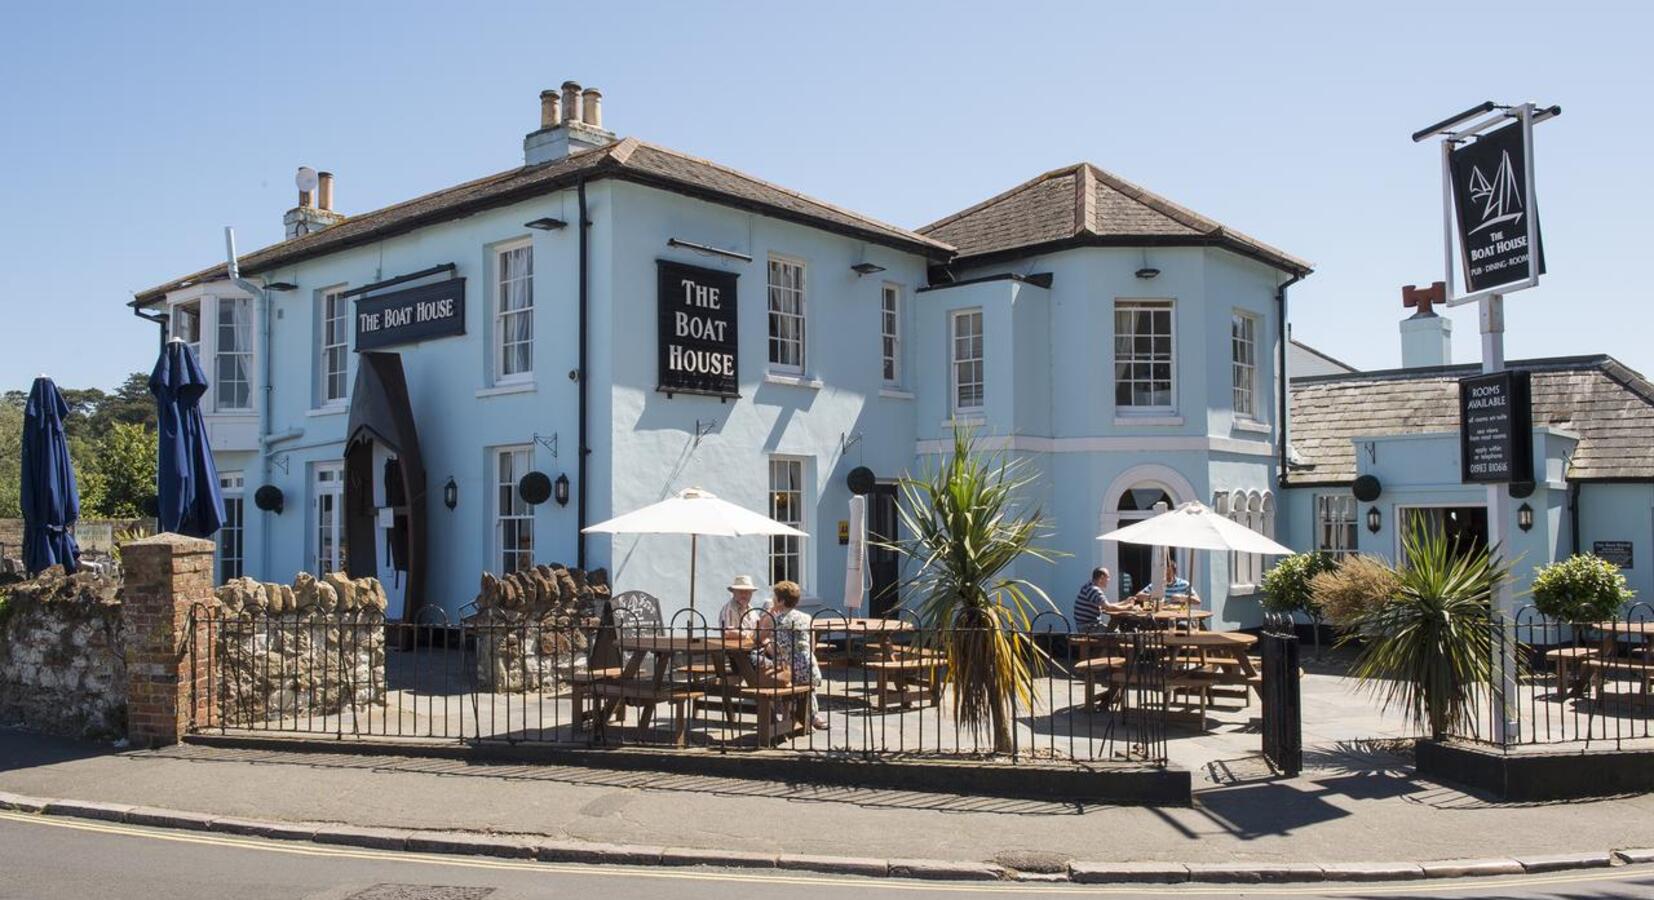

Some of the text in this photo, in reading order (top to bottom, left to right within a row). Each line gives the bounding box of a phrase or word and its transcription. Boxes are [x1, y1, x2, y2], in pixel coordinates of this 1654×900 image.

[1471, 236, 1527, 261] BOAT HOUSE
[1490, 231, 1503, 242] THE
[1471, 267, 1482, 277] PUB
[682, 279, 721, 310] THE
[360, 299, 453, 333] THE BOAT HOUSE
[675, 311, 727, 342] BOAT
[669, 344, 735, 376] HOUSE
[1467, 396, 1506, 409] AVAILABLE
[1472, 385, 1500, 398] ROOMS
